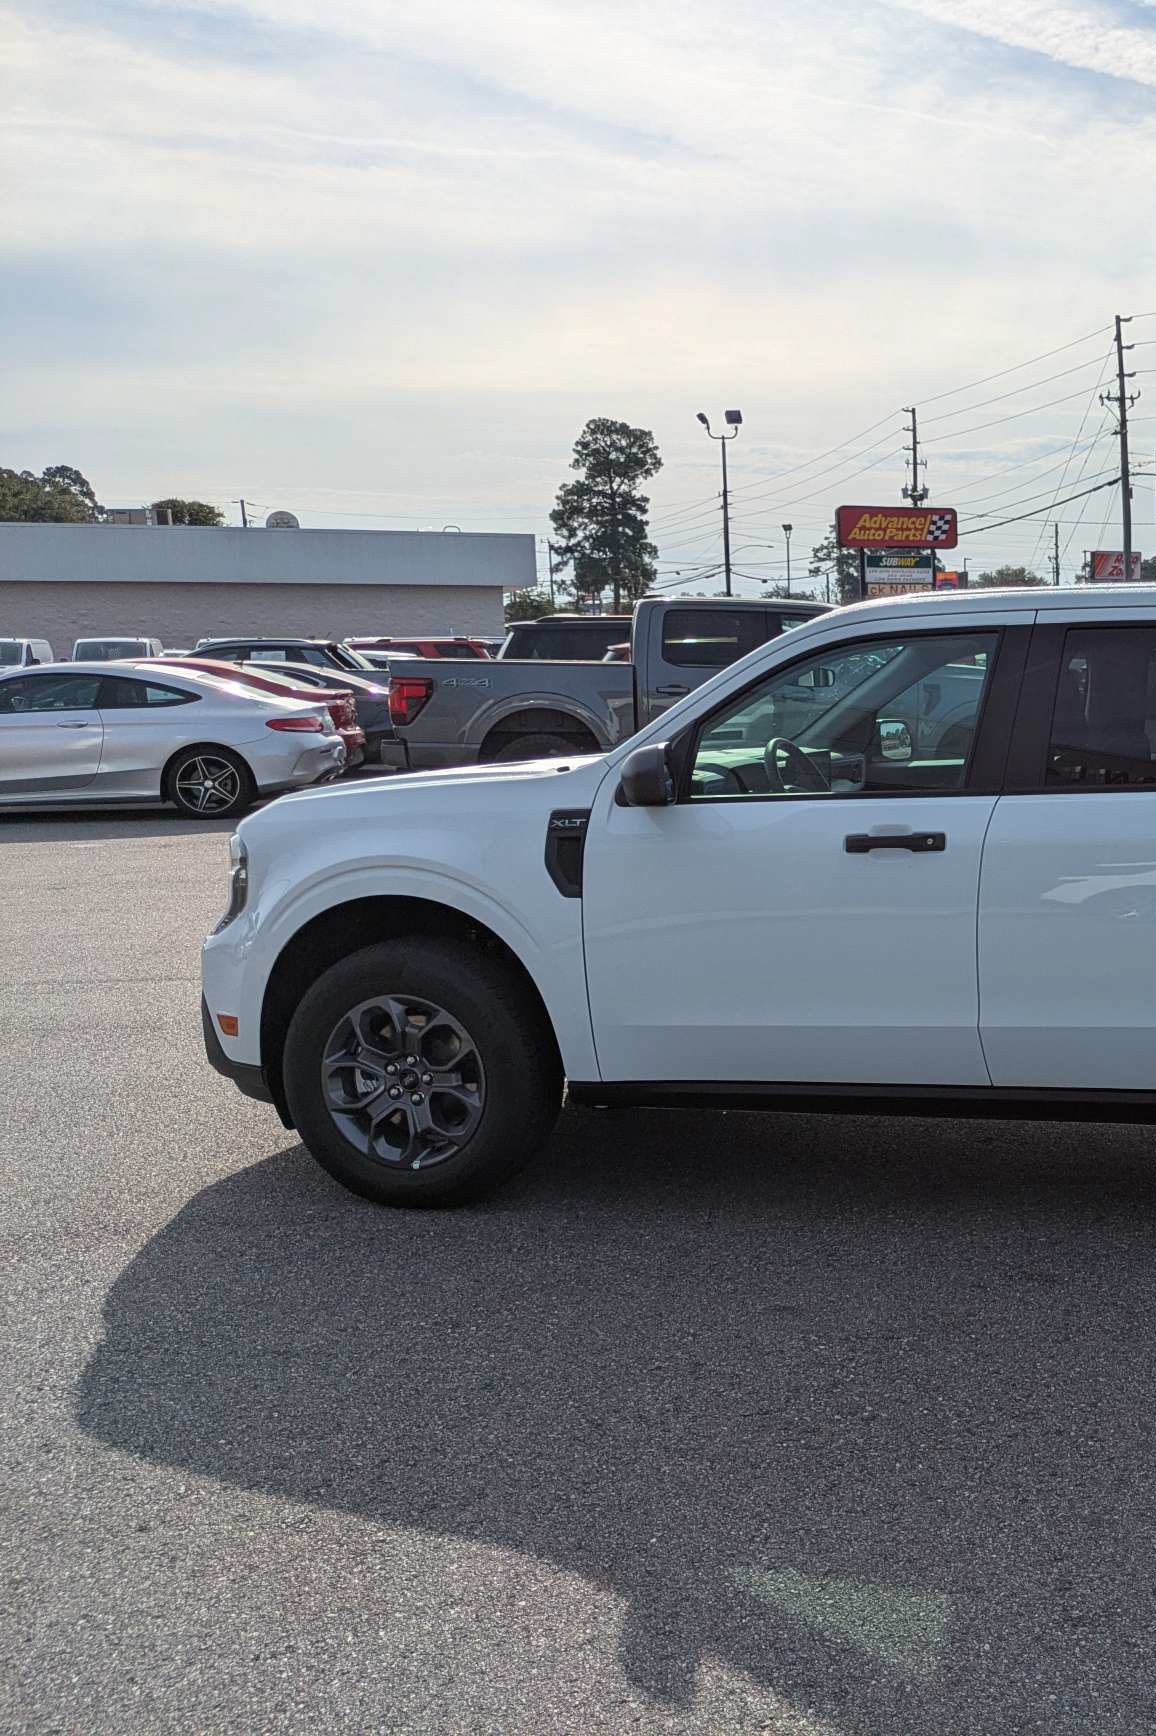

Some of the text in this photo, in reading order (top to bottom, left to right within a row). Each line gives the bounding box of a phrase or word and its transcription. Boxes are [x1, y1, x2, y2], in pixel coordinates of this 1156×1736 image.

[856, 514, 925, 528] Advance
[848, 527, 922, 541] Auto Parts
[880, 557, 919, 567] SUBWAY
[551, 819, 588, 827] XLT
